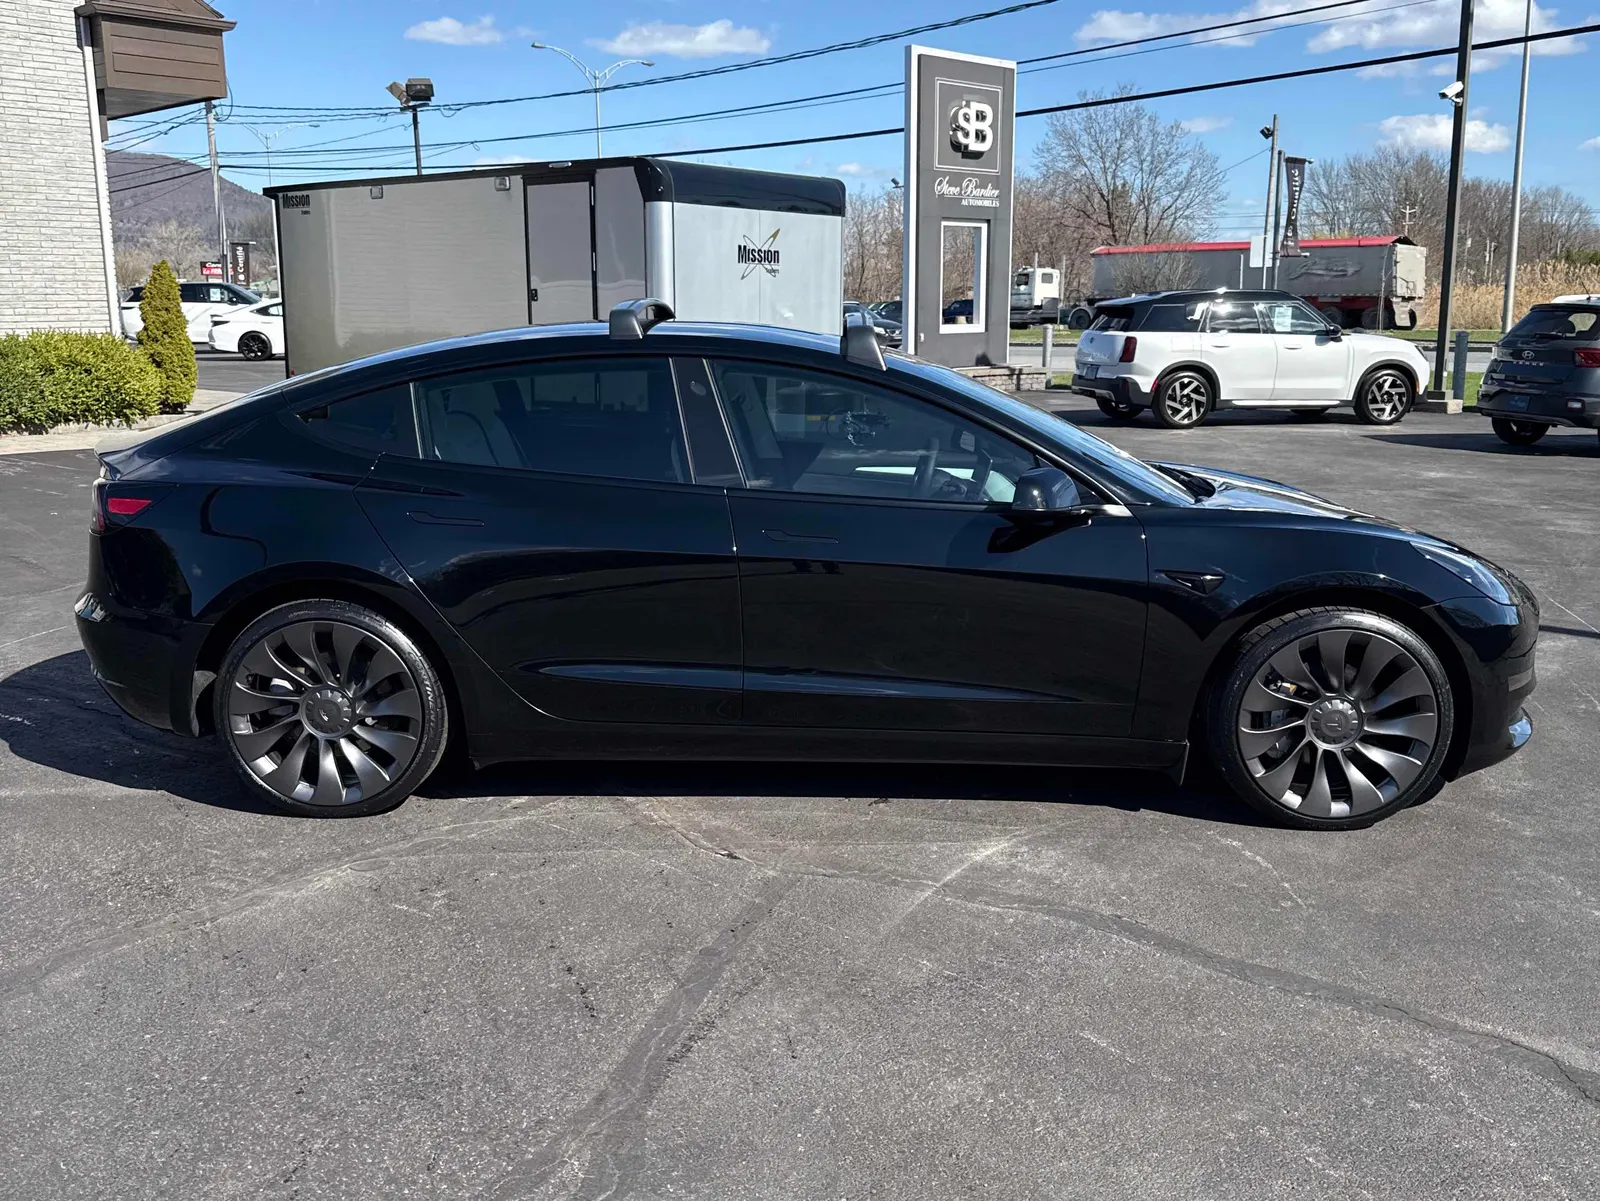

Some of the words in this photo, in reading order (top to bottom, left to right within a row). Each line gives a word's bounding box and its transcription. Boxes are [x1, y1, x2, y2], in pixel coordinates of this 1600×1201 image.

[934, 175, 960, 197] Steve
[282, 193, 310, 209] Mission
[961, 199, 999, 208] AUTOMOBILES
[737, 244, 780, 264] Mission
